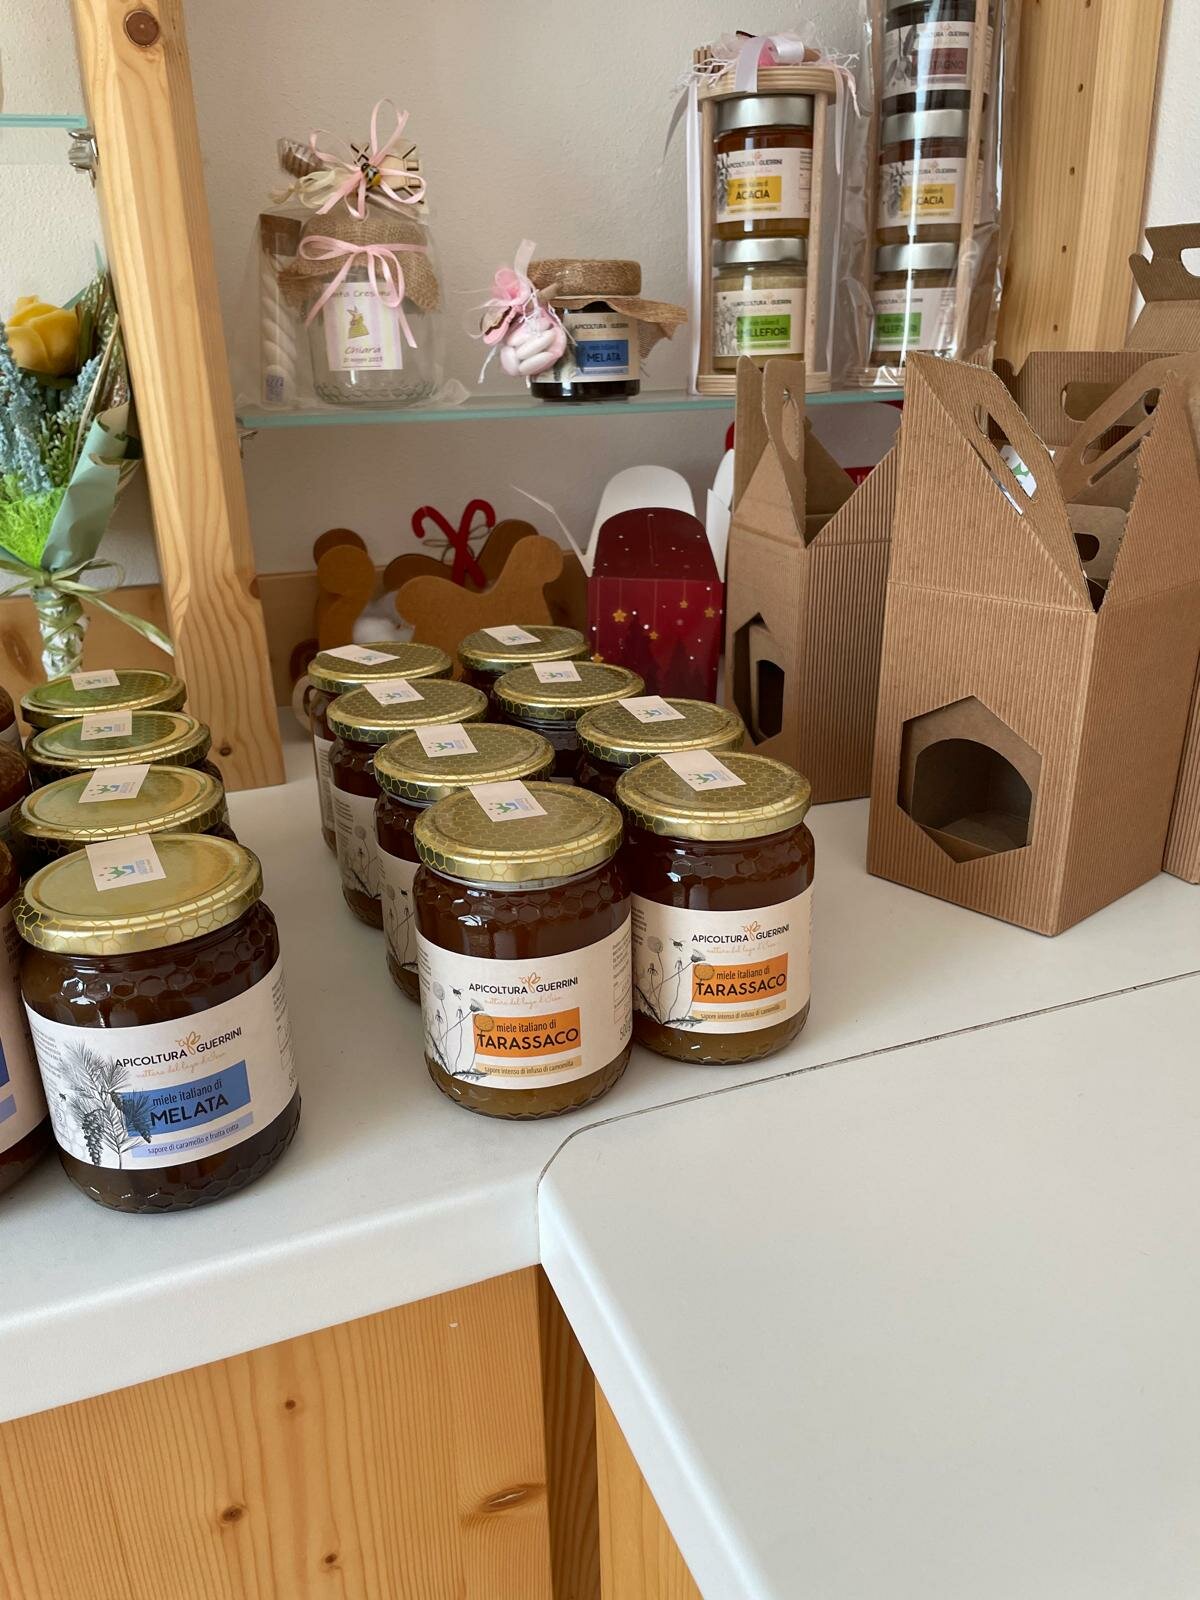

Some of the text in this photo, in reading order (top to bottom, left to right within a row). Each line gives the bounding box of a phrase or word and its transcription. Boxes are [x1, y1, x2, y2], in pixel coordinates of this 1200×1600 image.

[736, 189, 770, 201] ACACIA
[912, 196, 944, 206] CACIA
[353, 290, 391, 298] Cresma
[586, 352, 621, 363] MELATA
[691, 924, 790, 944] APICOLTURA GUERRINI
[716, 966, 770, 980] miele italiano di
[469, 977, 579, 995] APICOLTURA GUERRINI
[696, 973, 786, 996] TARASSACO
[497, 1019, 557, 1033] miele italiano di
[115, 1027, 242, 1068] APICOLTURA GUERRINI
[477, 1028, 579, 1050] TARASSACO
[153, 1078, 222, 1107] miele italiano di
[149, 1094, 229, 1127] MELATA
[147, 1144, 168, 1155] sapore
[175, 1137, 205, 1151] caramello
[209, 1129, 226, 1141] frutta
[226, 1123, 239, 1135] cotta
